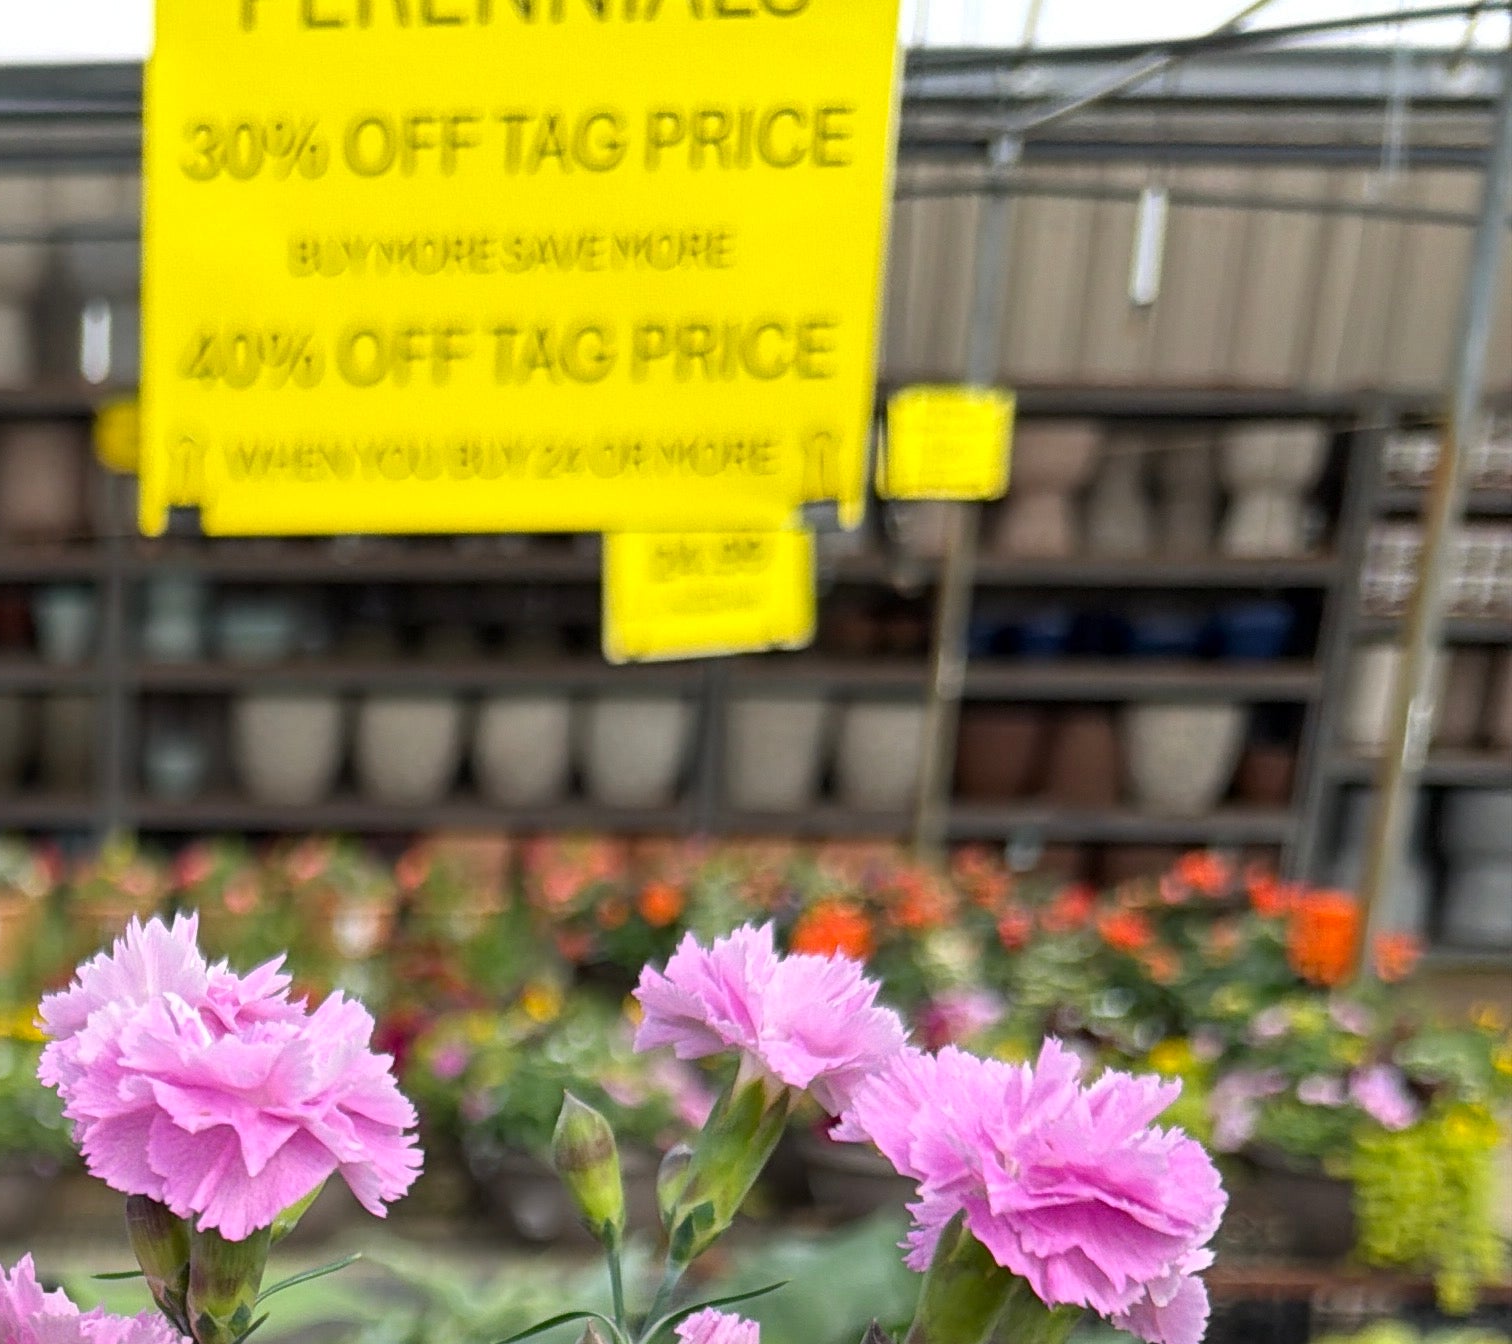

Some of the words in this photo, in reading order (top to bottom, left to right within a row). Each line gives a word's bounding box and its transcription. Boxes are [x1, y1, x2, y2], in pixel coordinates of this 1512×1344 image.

[180, 107, 330, 181] 30%
[343, 107, 480, 178] OFF
[499, 105, 627, 176] TAG
[643, 100, 856, 172] PRICE
[287, 227, 374, 276] BUY
[376, 226, 498, 275] MORE
[501, 225, 608, 274] SAVE
[610, 224, 737, 272] MORE
[178, 320, 326, 389] 40%
[335, 318, 475, 388] OFF
[482, 317, 617, 386] TAG
[629, 313, 838, 383] PRICE
[354, 436, 443, 481] YOU
[655, 433, 781, 477] MORE
